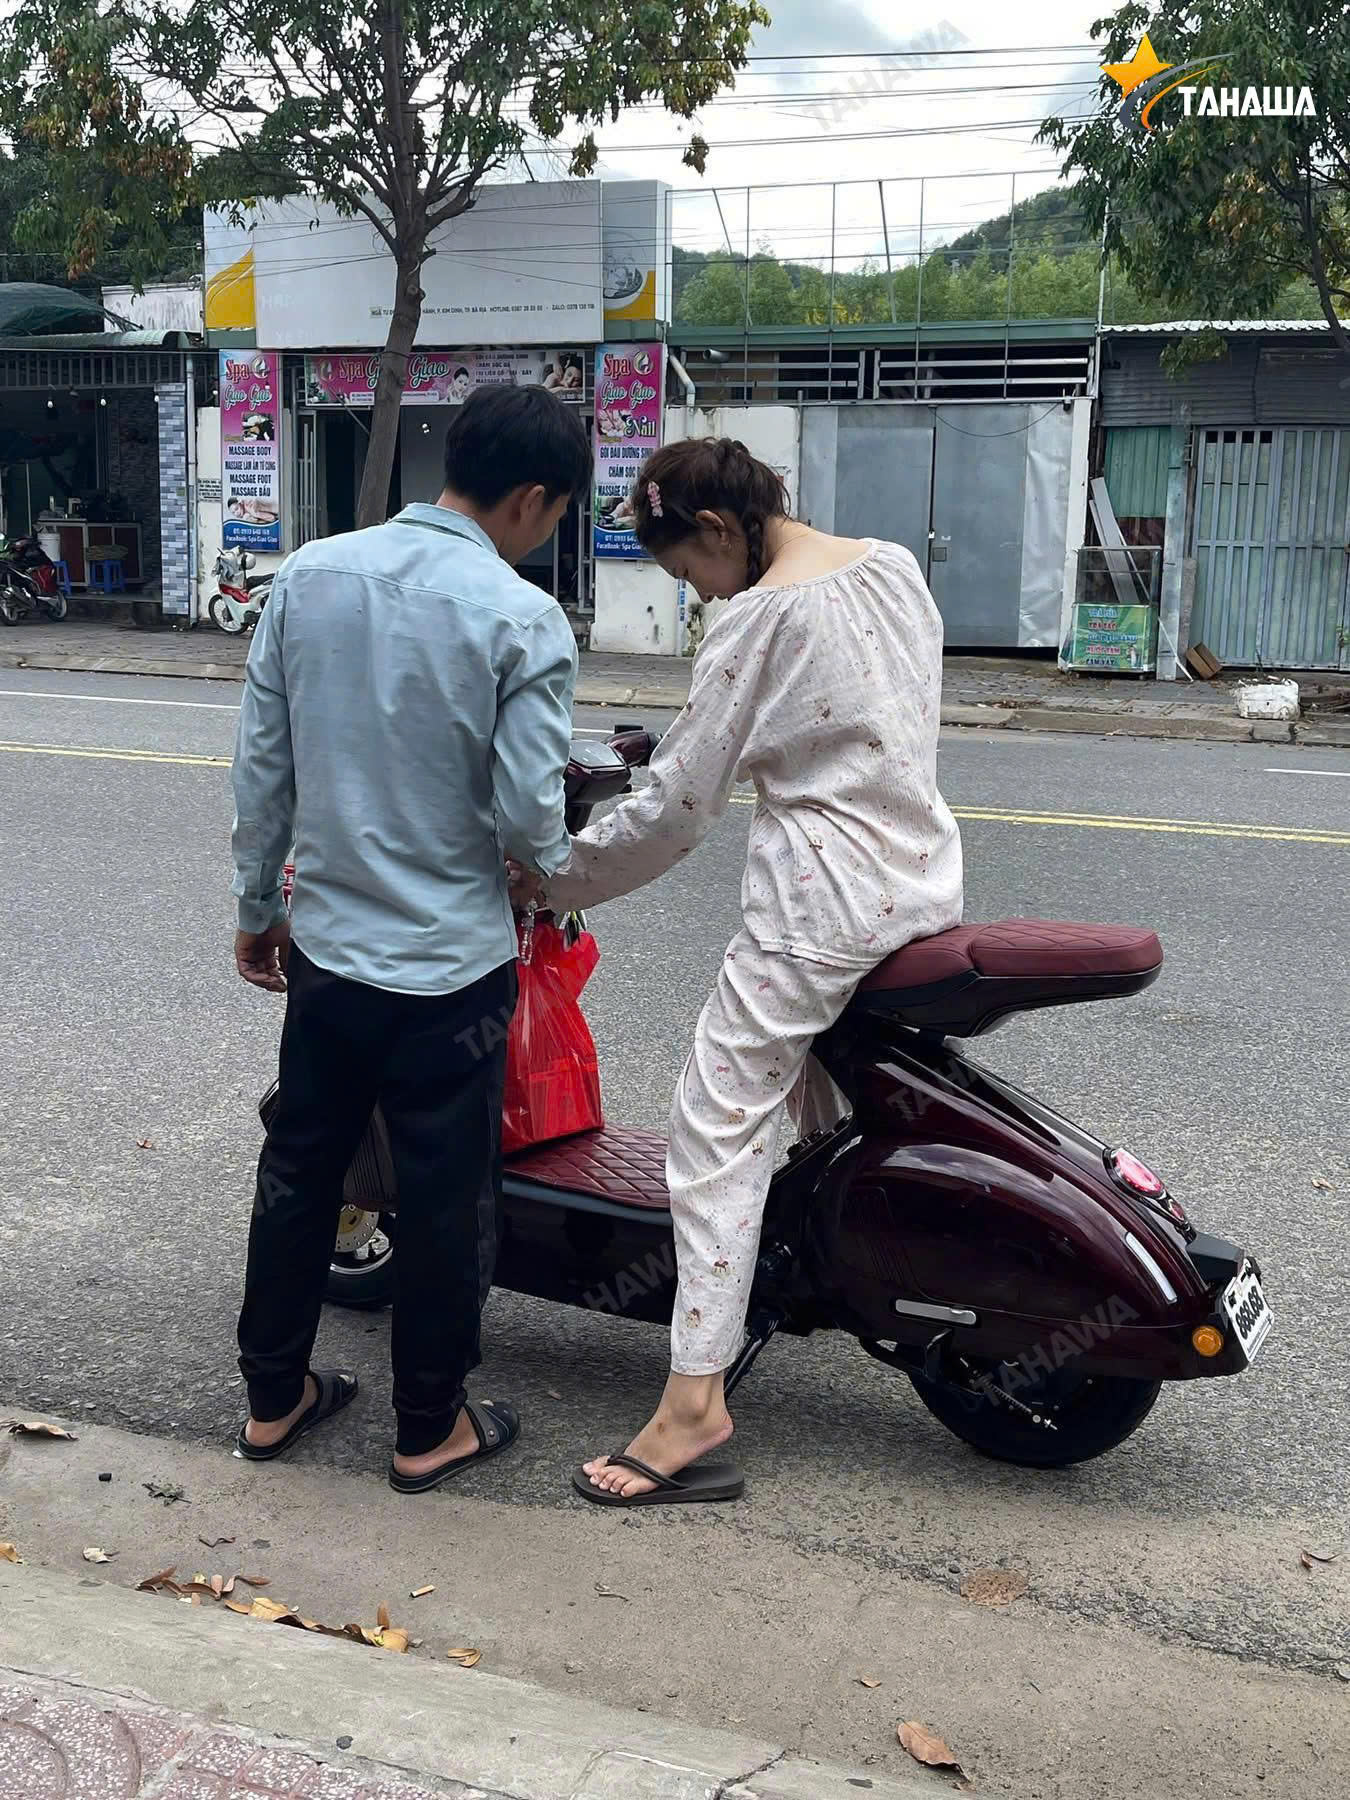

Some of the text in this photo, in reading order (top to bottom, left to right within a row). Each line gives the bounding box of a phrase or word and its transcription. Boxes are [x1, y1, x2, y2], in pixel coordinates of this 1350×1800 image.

[225, 359, 250, 384] Spa
[340, 360, 365, 383] Spa
[408, 353, 450, 389] Giao
[603, 353, 631, 380] Spa
[224, 383, 273, 411] Giao Giao
[601, 380, 656, 410] Giao Giao
[624, 416, 657, 438] Nail
[229, 446, 271, 456] MASSAGE BODY
[230, 474, 271, 484] MASSAGE FOOT
[231, 487, 257, 497] MASSAGE
[598, 485, 620, 497] MASSAGE
